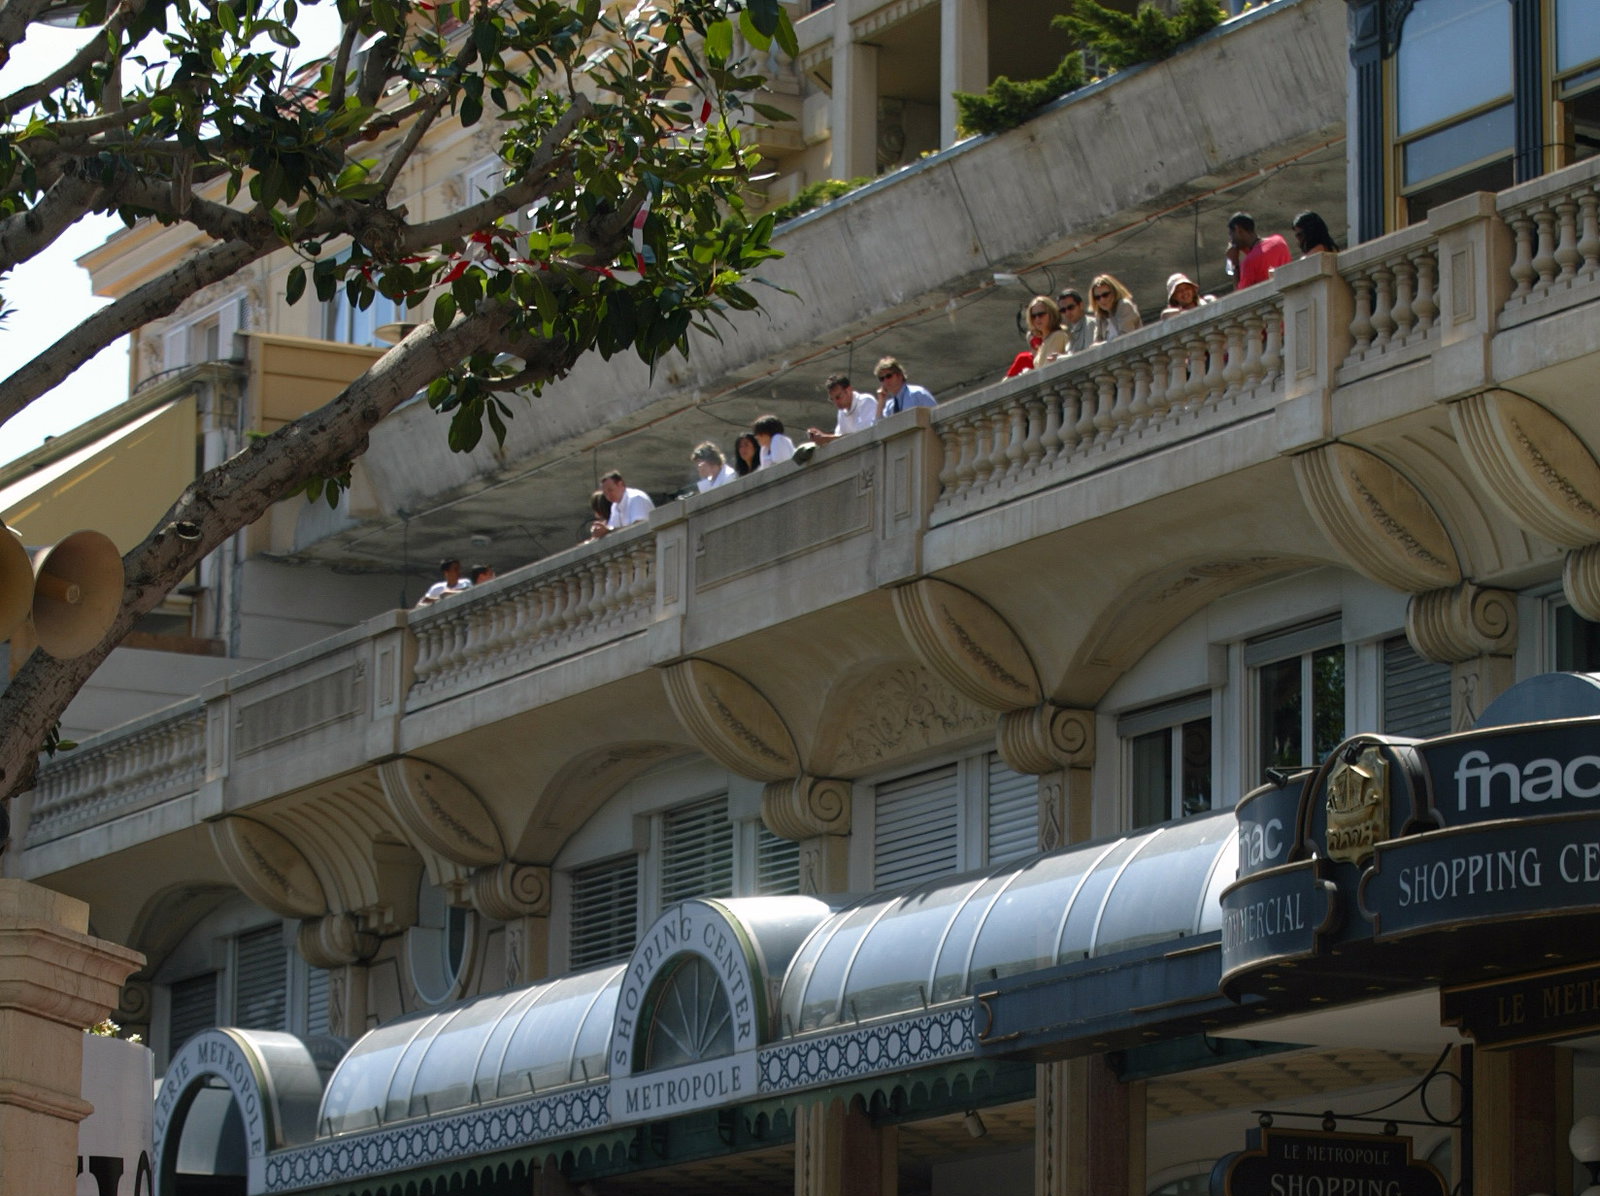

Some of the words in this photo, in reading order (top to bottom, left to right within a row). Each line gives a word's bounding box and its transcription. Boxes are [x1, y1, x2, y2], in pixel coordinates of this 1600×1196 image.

[1454, 751, 1600, 811] fnac
[1399, 847, 1541, 907] SHOPPING
[615, 916, 692, 1066] SHOPPING
[703, 922, 750, 1042] CENTER
[1496, 993, 1527, 1027] LE
[198, 1041, 262, 1155] METROPOLE
[626, 1066, 742, 1114] METROPOLE
[1284, 1143, 1300, 1160] LE
[1306, 1144, 1390, 1165] METROPOLE
